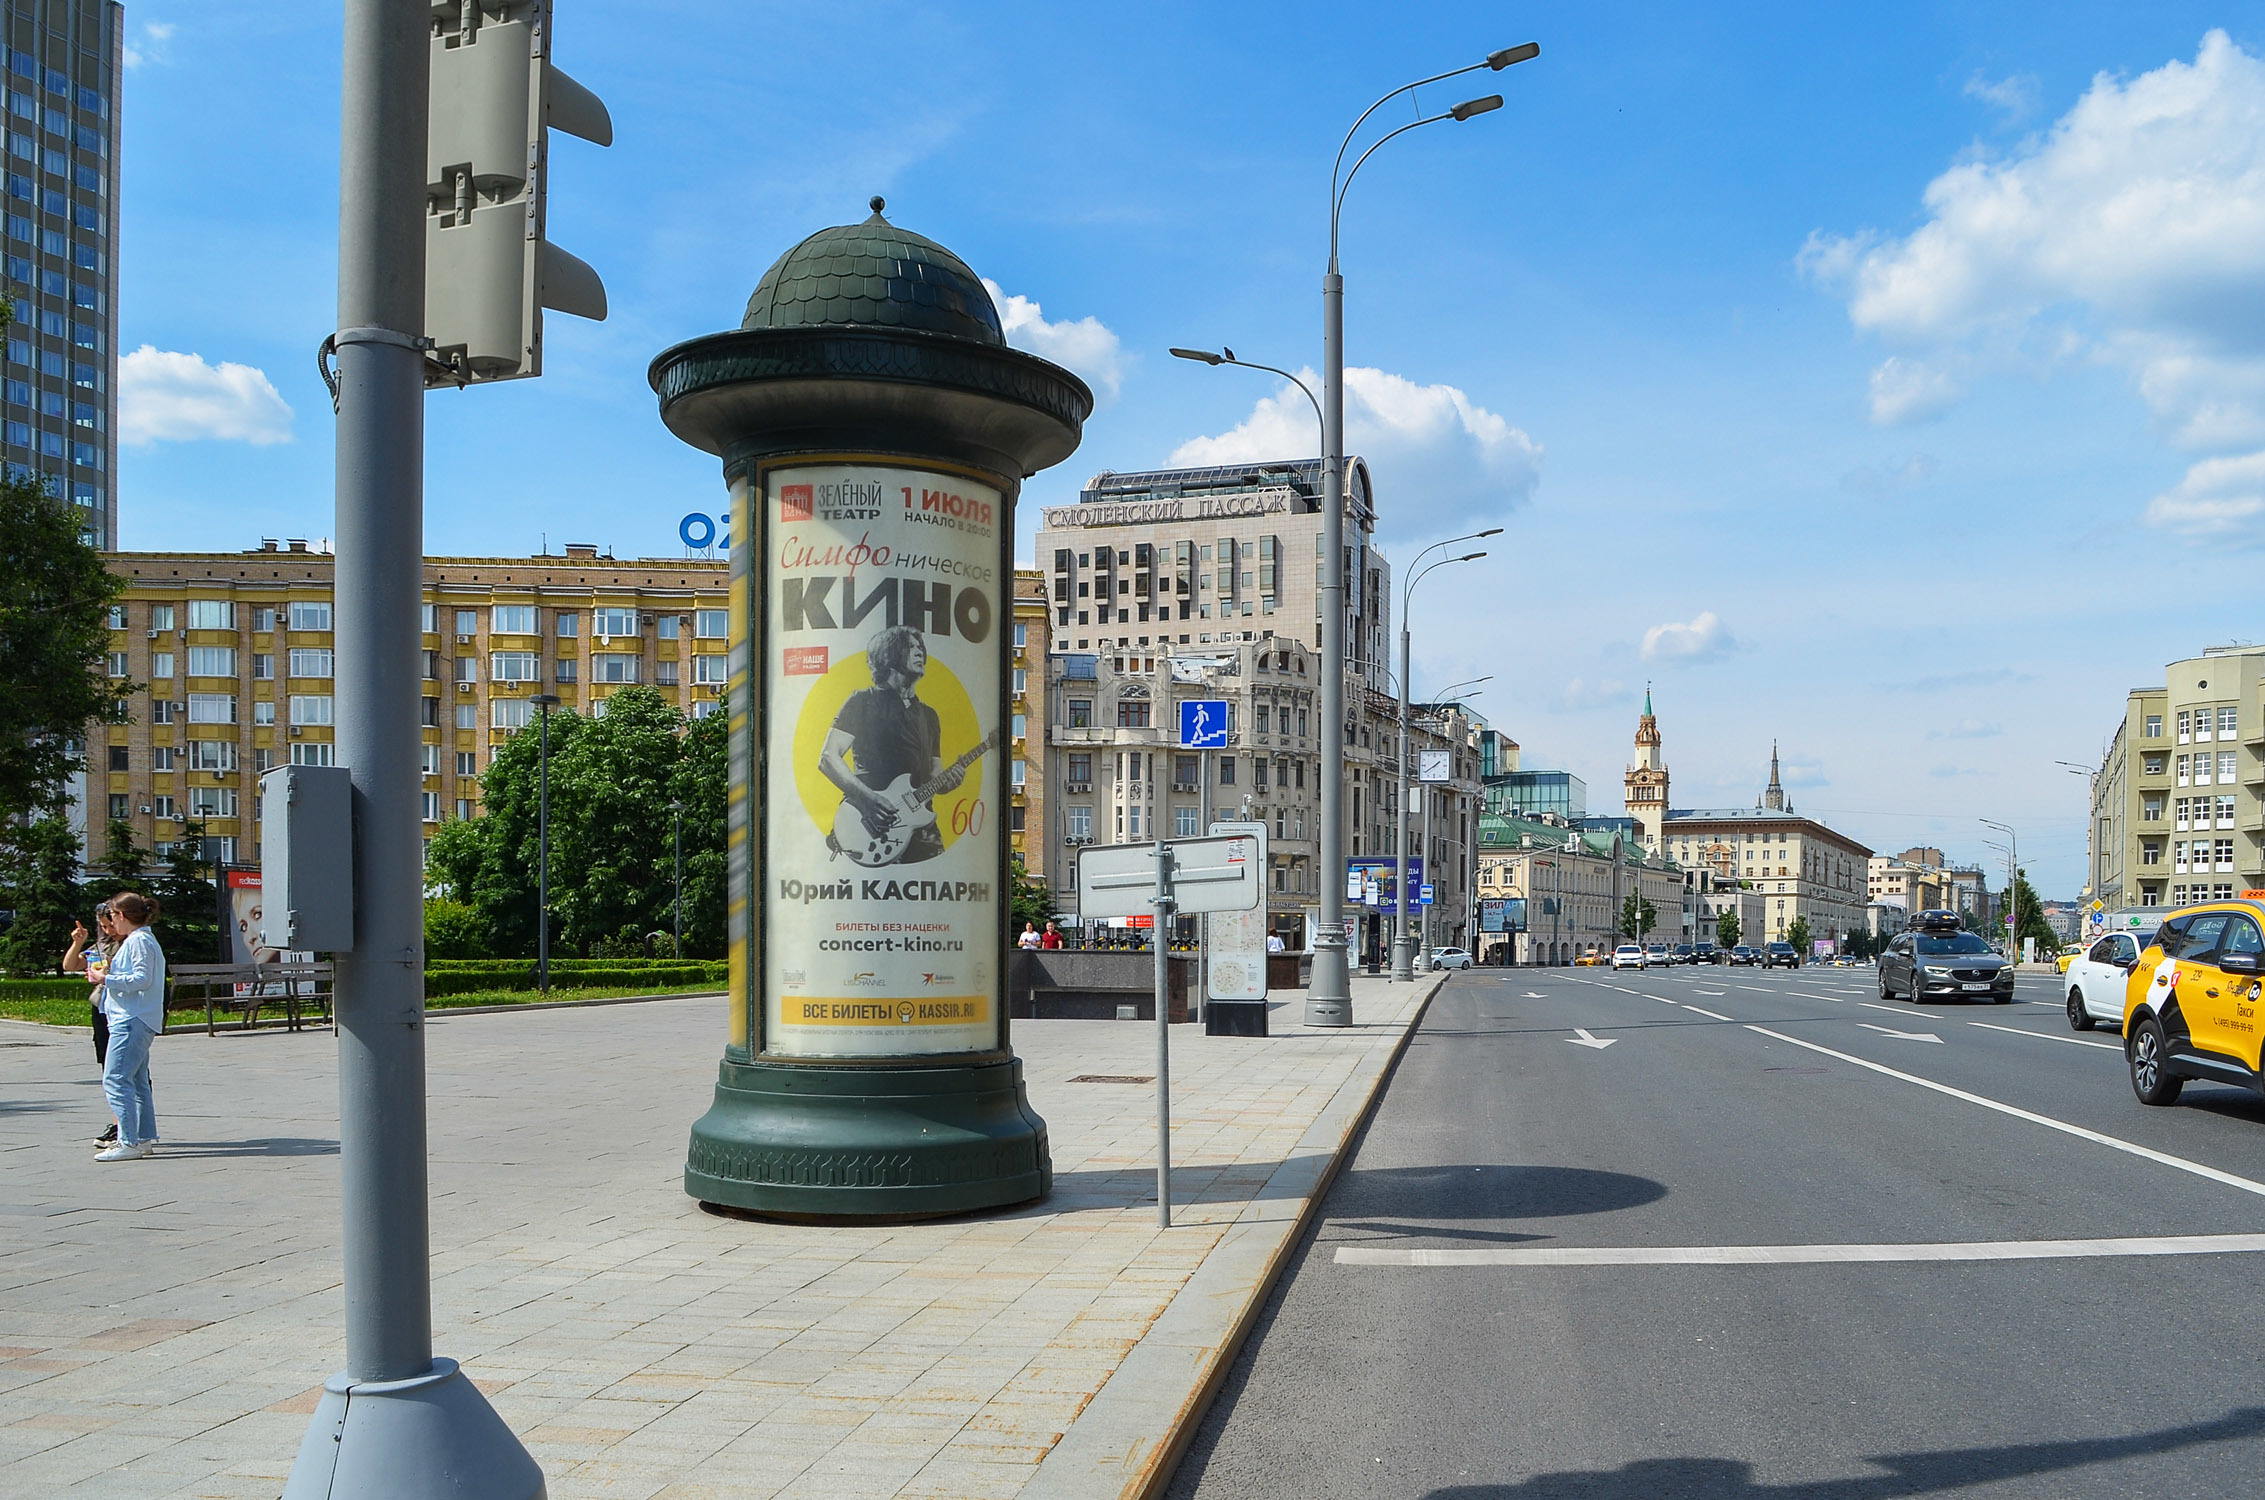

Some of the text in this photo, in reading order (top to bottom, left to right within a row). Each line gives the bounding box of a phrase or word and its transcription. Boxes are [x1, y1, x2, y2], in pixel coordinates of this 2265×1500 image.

[818, 479, 882, 507] ЗЕЛЁНЫЙ
[821, 509, 881, 520] ТЕАТР
[901, 487, 993, 525] 1 ИЮЛЯ
[1048, 494, 1287, 527] СМОЛЕНСКИЙ ПАССАЖ
[904, 511, 956, 529] НАЧАЛО
[783, 577, 991, 644] КИНО
[802, 655, 825, 664] НАШЕ
[952, 798, 985, 836] 60
[781, 879, 990, 904] Юрий КАСПАРЯН
[835, 923, 950, 932] БИЛЕТЫ БЕЗ НАЦЕНКИ
[819, 937, 963, 952] concert-kino.ru
[2249, 984, 2260, 999] Go
[803, 1003, 892, 1019] ВСЕ БИЛЕТЫ
[2236, 1003, 2255, 1018] Такси
